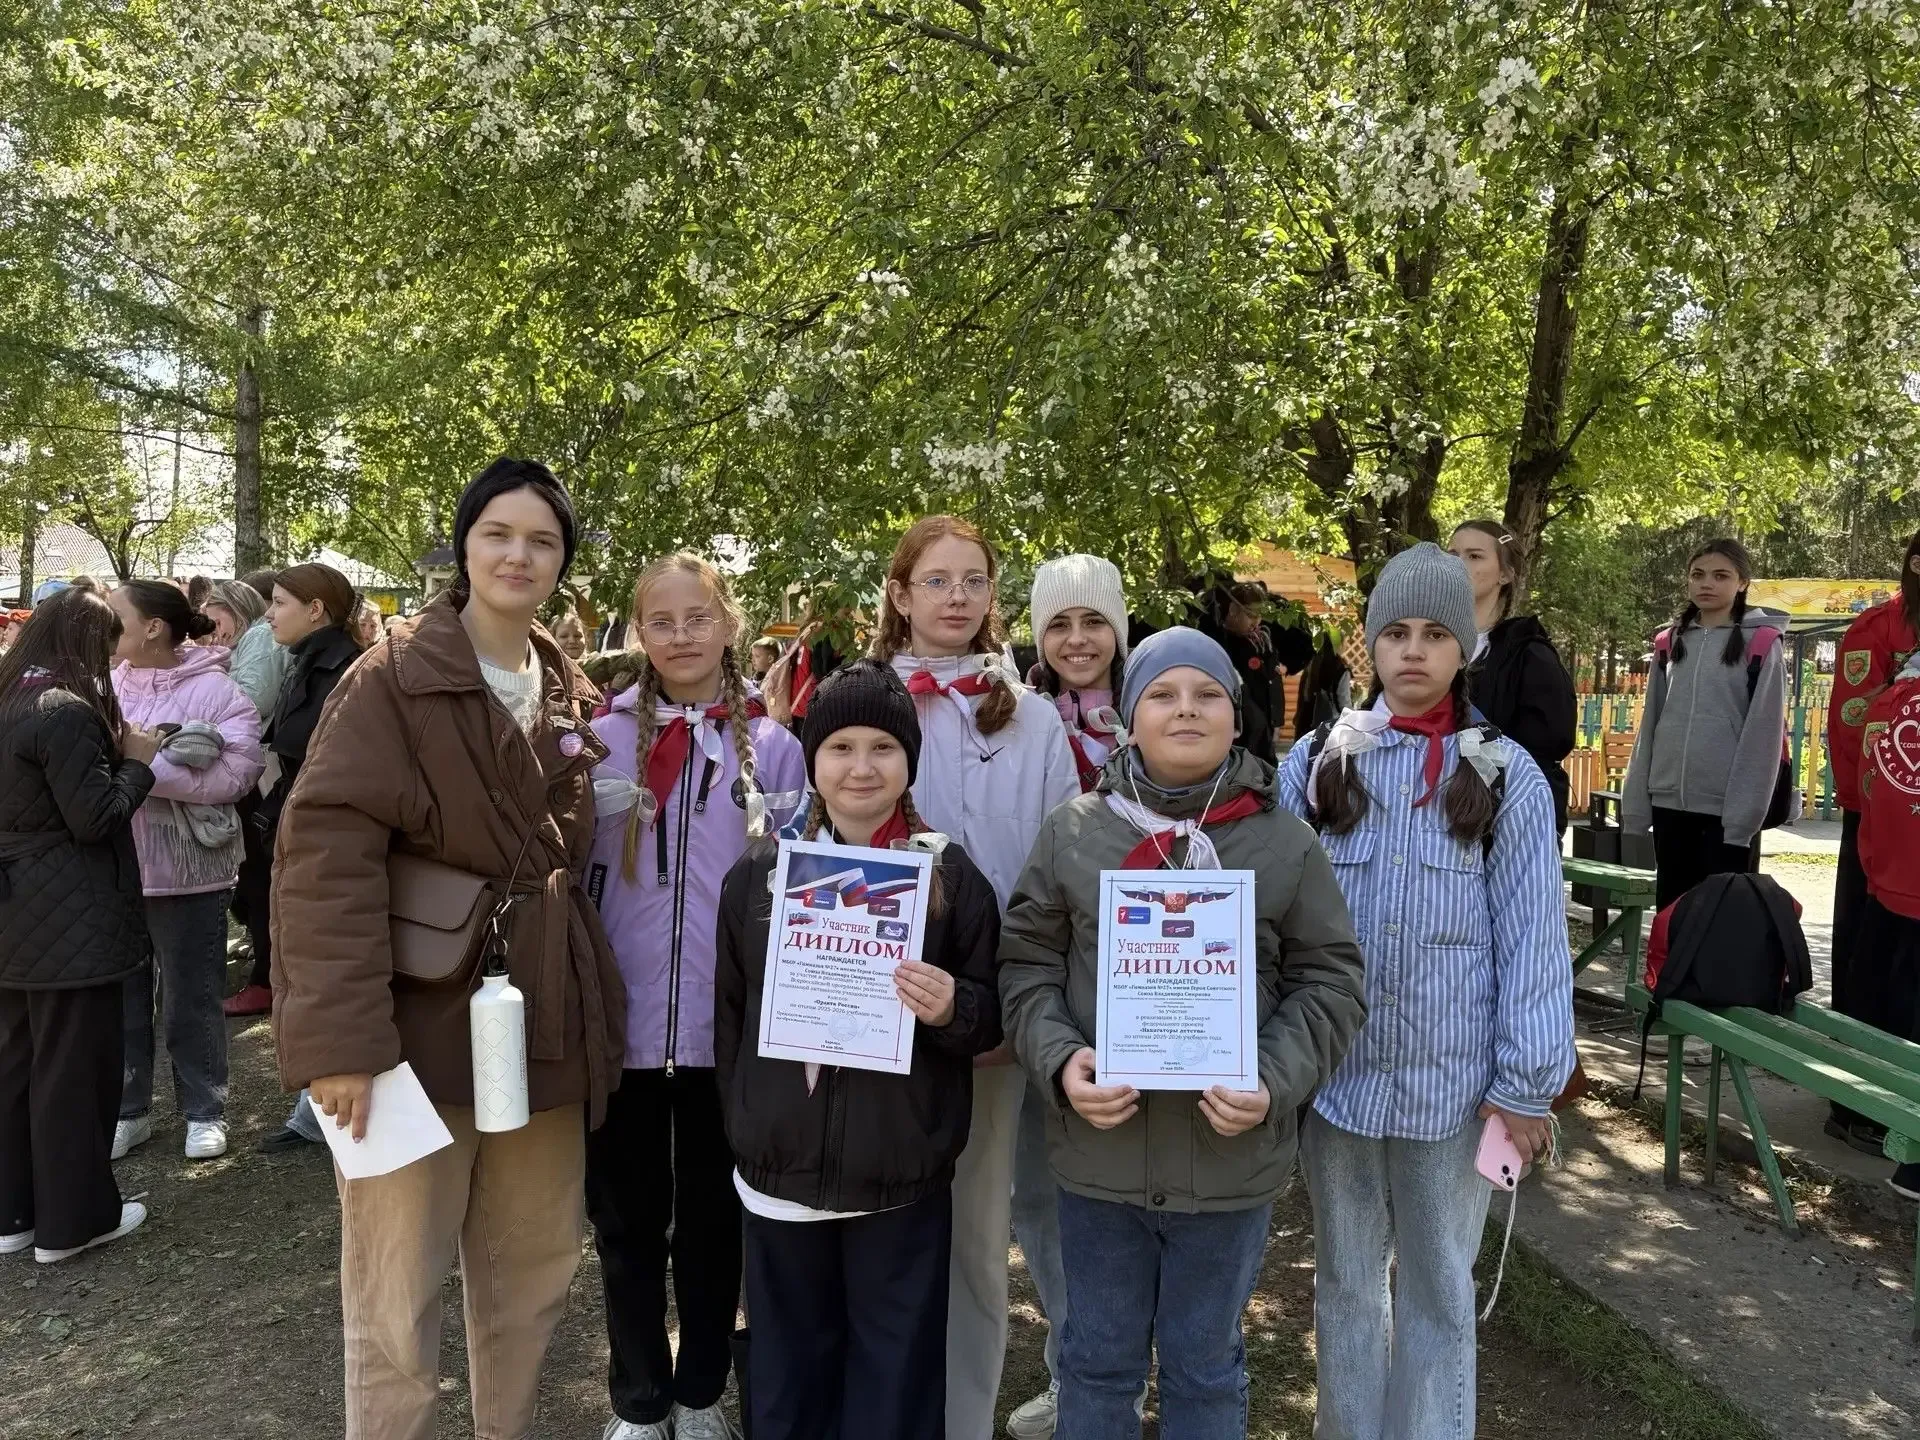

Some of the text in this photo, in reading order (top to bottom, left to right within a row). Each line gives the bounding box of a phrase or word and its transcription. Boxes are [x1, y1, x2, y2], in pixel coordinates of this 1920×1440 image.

[821, 917, 870, 933] Участник
[784, 931, 905, 960] ДИПЛОМ
[1117, 938, 1179, 953] Участник
[816, 954, 866, 965] НАГРАЖДАЕТСЯ
[1113, 958, 1236, 978] ДИПЛОМ
